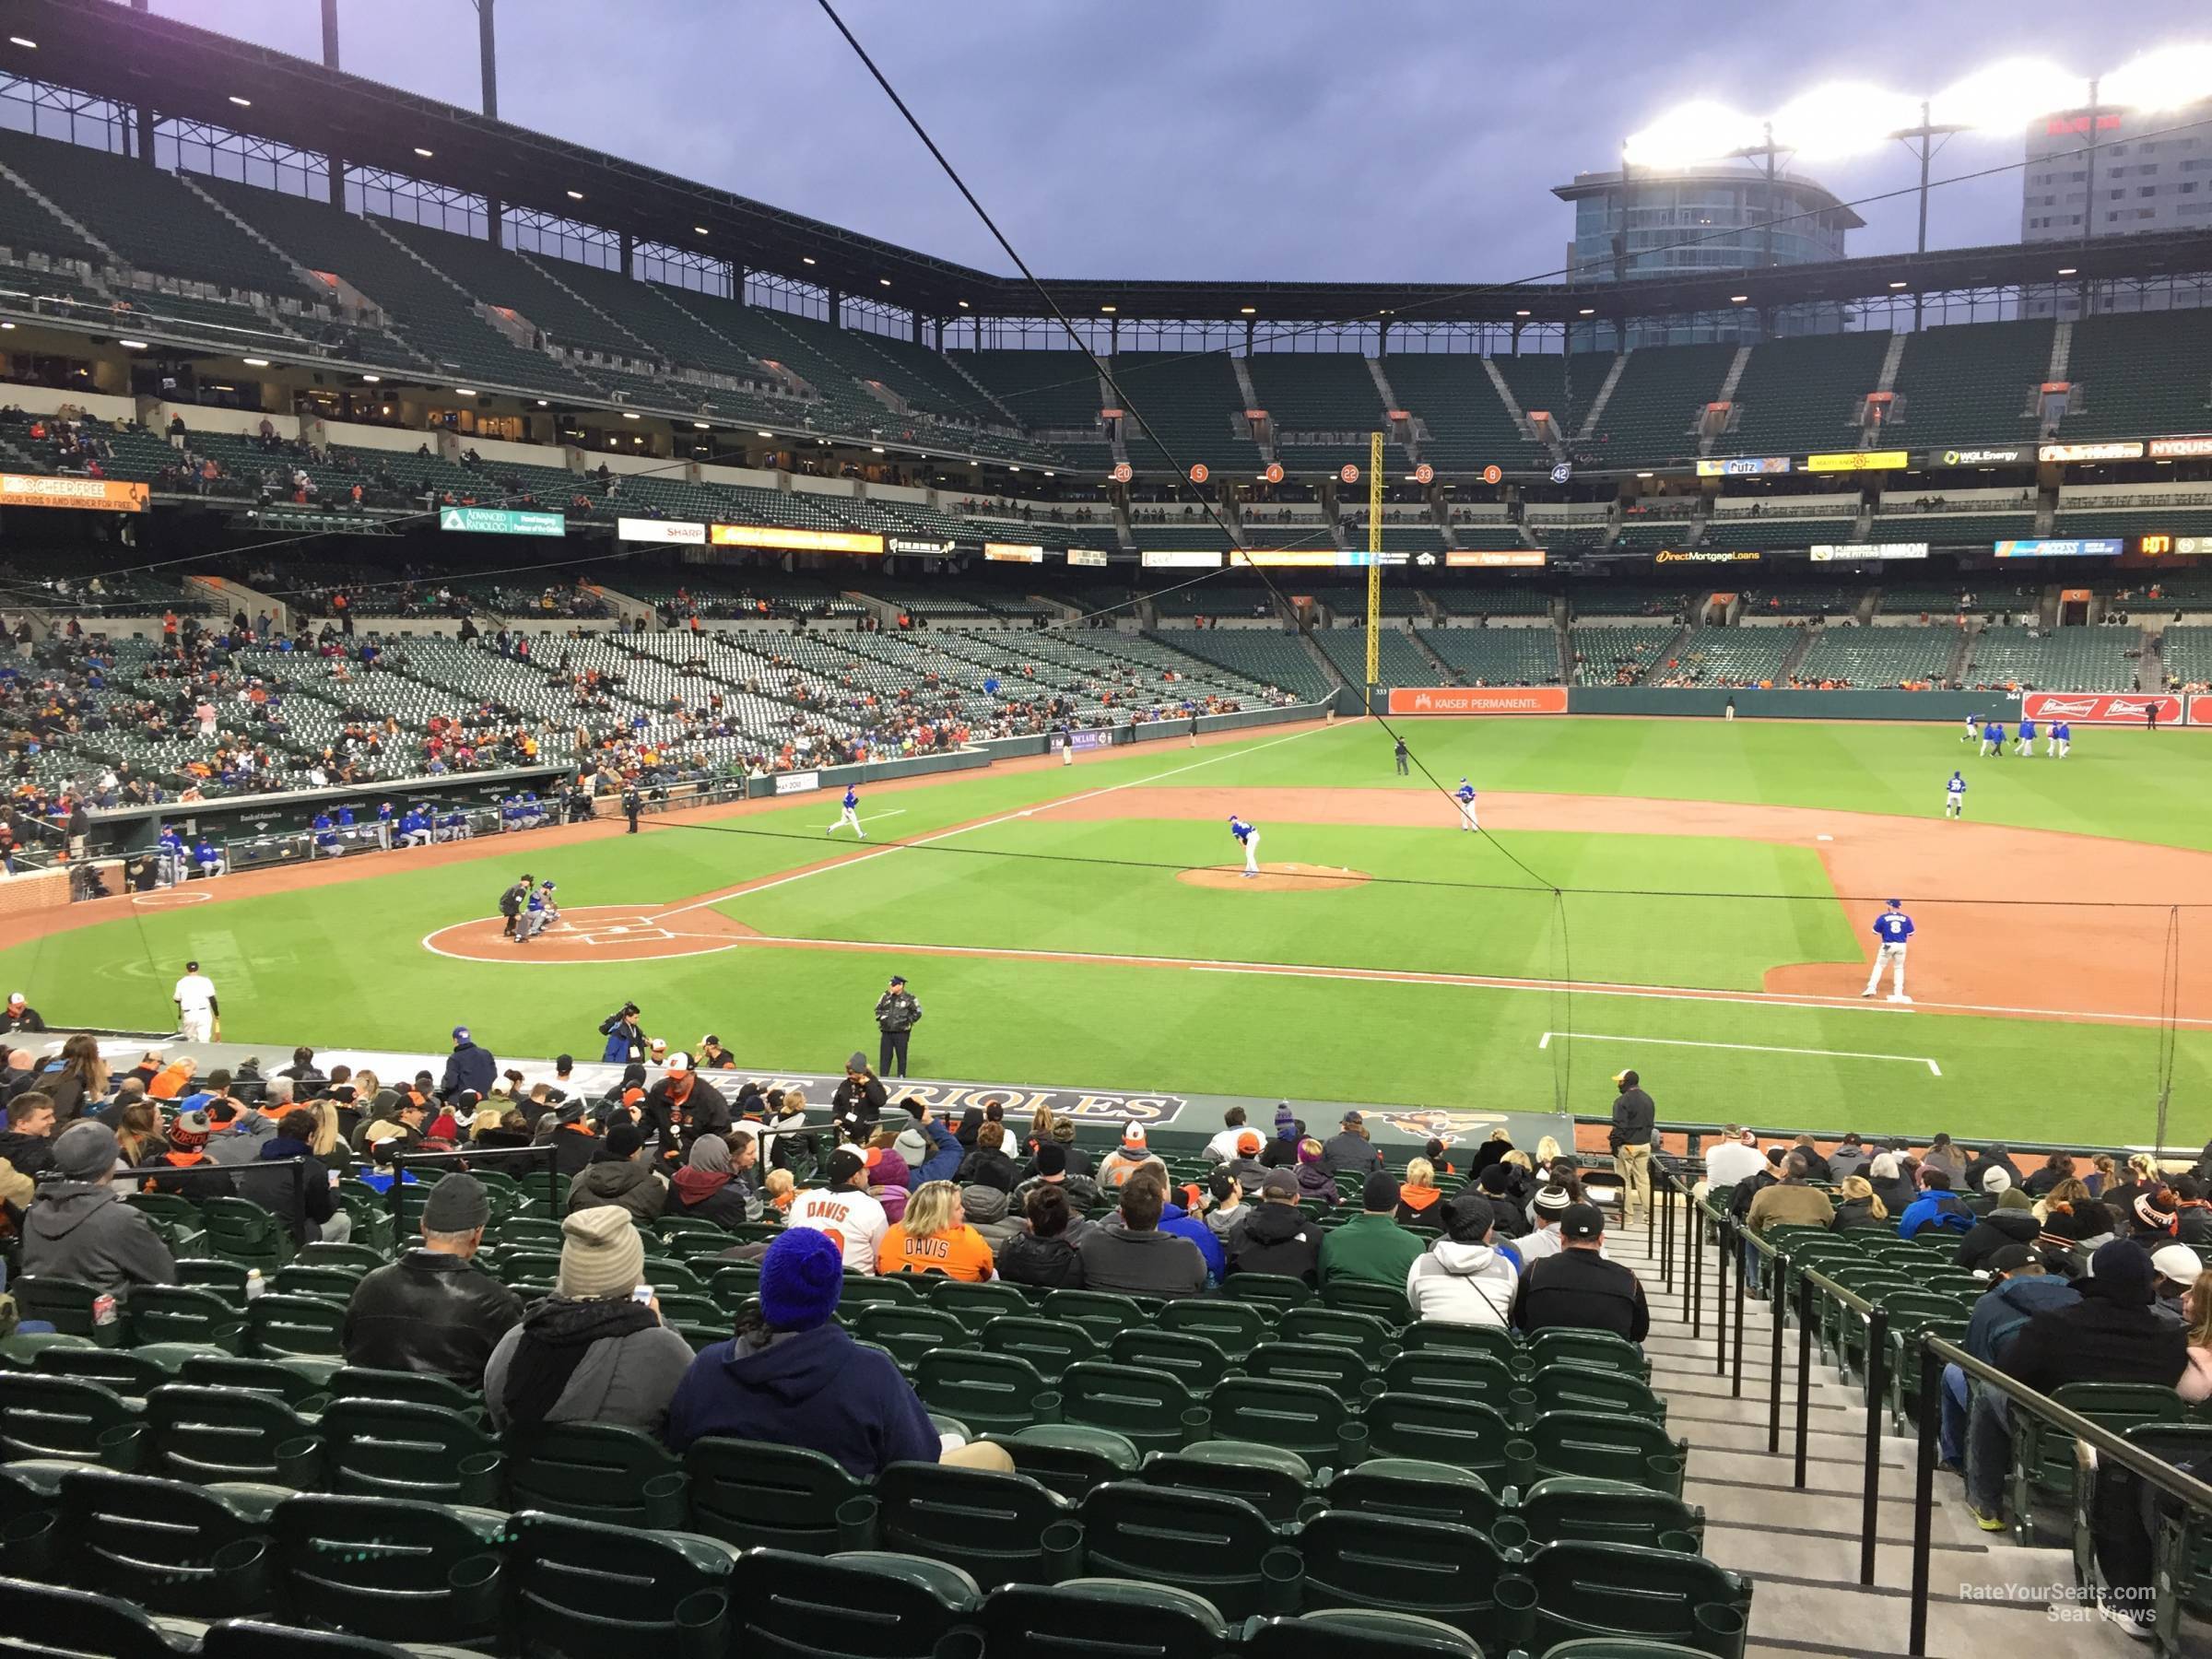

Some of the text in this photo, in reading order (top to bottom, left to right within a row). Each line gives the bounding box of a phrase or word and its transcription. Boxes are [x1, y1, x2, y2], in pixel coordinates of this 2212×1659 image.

[1116, 468, 1129, 478] 20
[1196, 469, 1203, 478] 5
[1271, 469, 1278, 478] 4
[1344, 469, 1357, 479] 22
[1418, 469, 1431, 478] 33
[1489, 469, 1496, 479] 8
[1553, 468, 1566, 478] 42
[37, 480, 74, 495] CHEER
[76, 483, 103, 496] FREE
[666, 528, 703, 537] SHARP
[1435, 698, 1537, 709] KAISER PERMANENTE
[1890, 921, 1901, 934] 8
[807, 1201, 850, 1223] DAVIS
[905, 1238, 950, 1258] DAVIS
